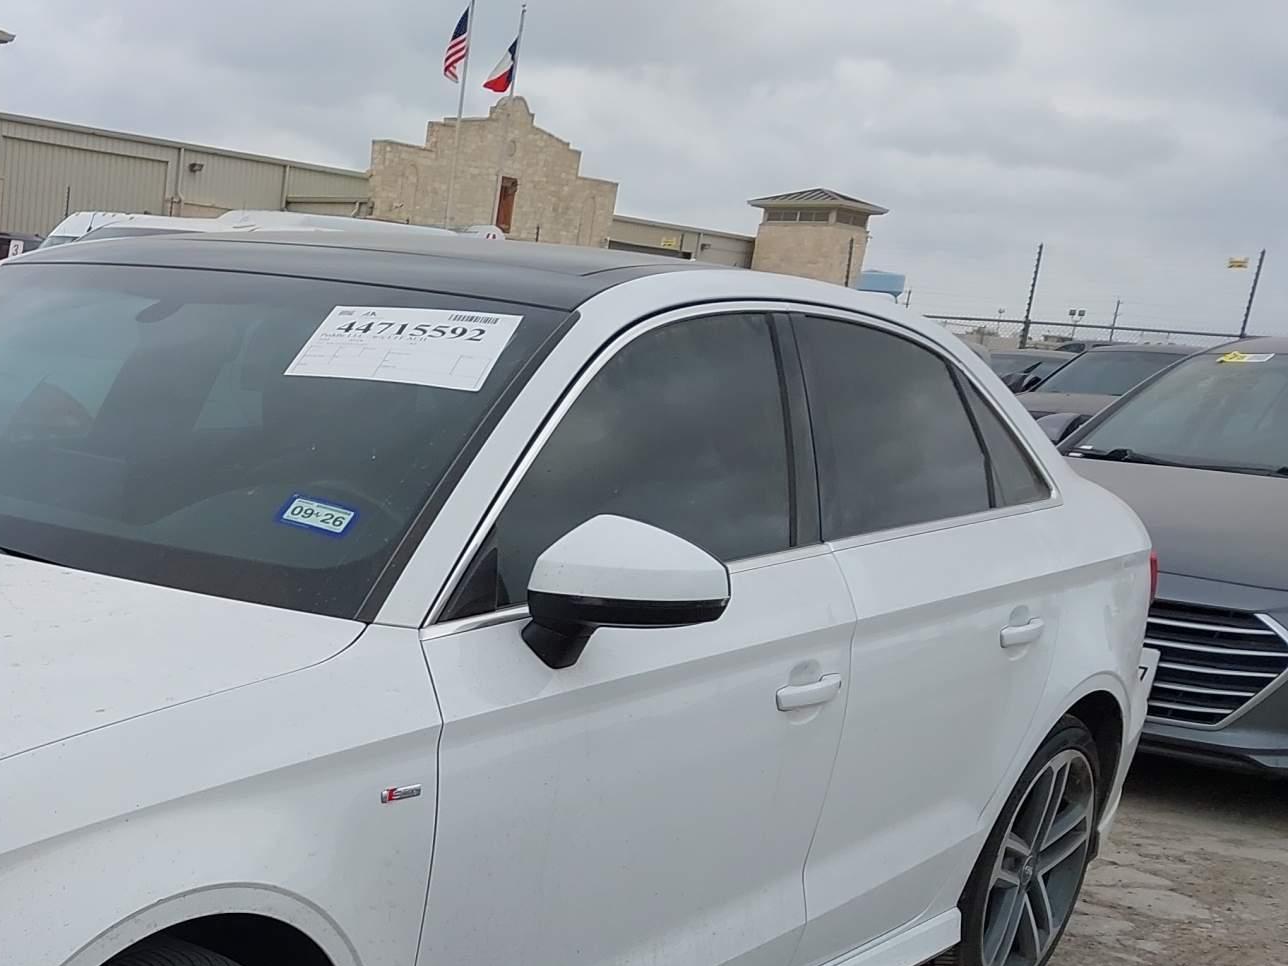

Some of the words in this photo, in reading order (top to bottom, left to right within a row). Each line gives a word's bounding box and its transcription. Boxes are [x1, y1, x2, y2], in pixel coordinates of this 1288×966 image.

[336, 320, 486, 342] 44715592
[290, 505, 314, 519] 09
[320, 512, 346, 527] 26
